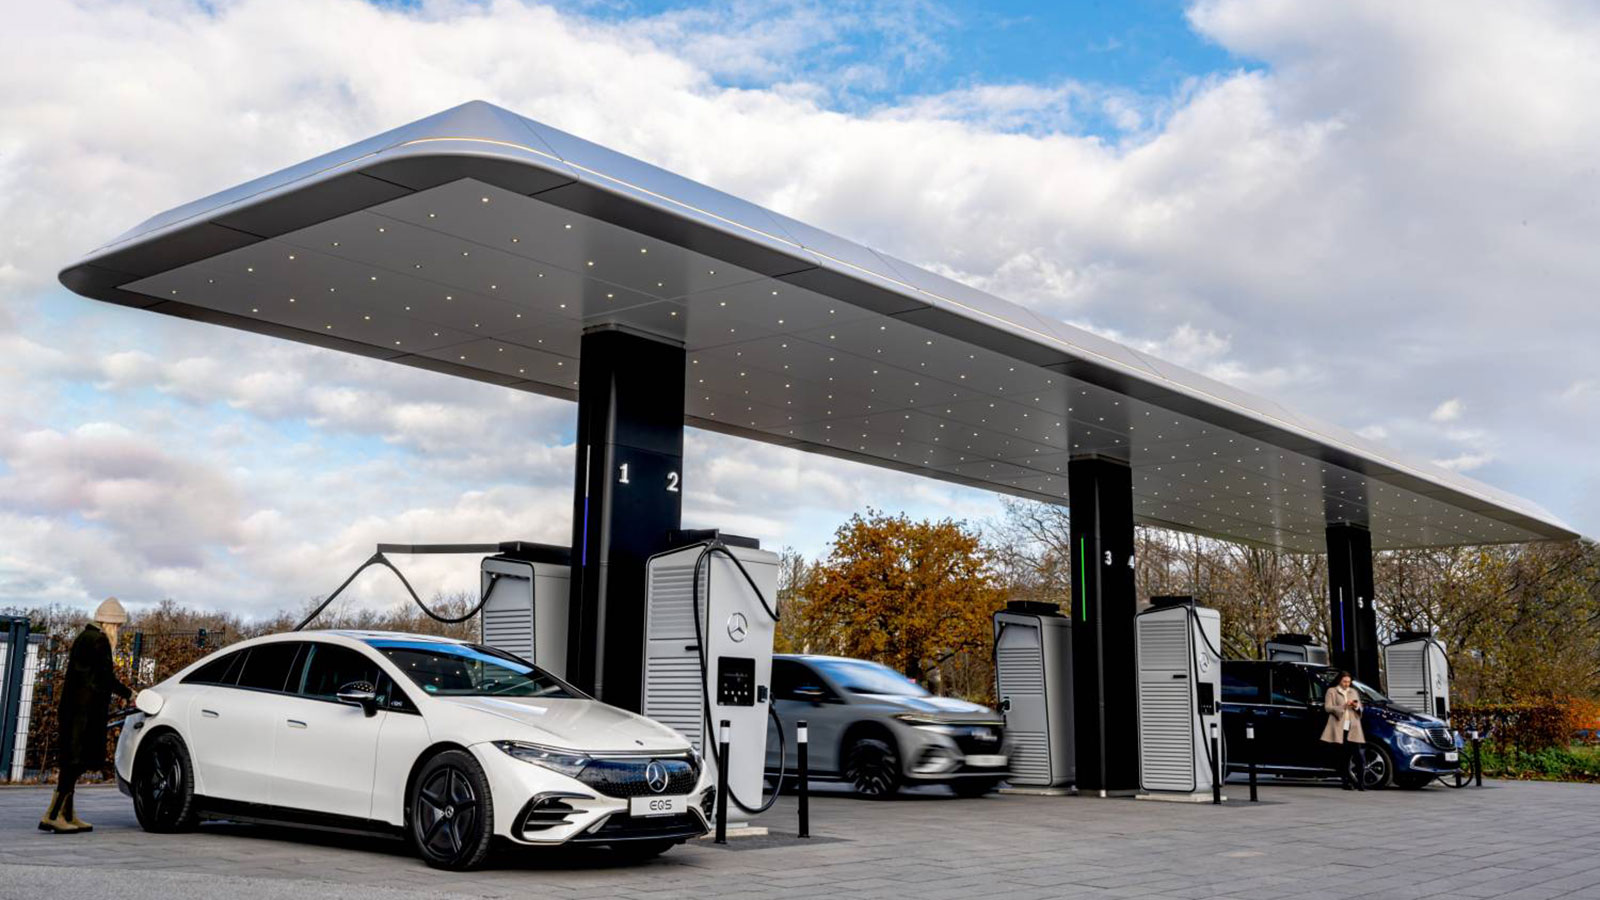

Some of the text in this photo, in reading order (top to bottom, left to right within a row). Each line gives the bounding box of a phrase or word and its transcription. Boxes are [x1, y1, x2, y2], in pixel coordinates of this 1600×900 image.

[619, 463, 629, 484] 1
[666, 471, 679, 492] 2
[1104, 550, 1112, 565] 3
[1127, 555, 1135, 569] 4
[649, 799, 673, 811] EQS
